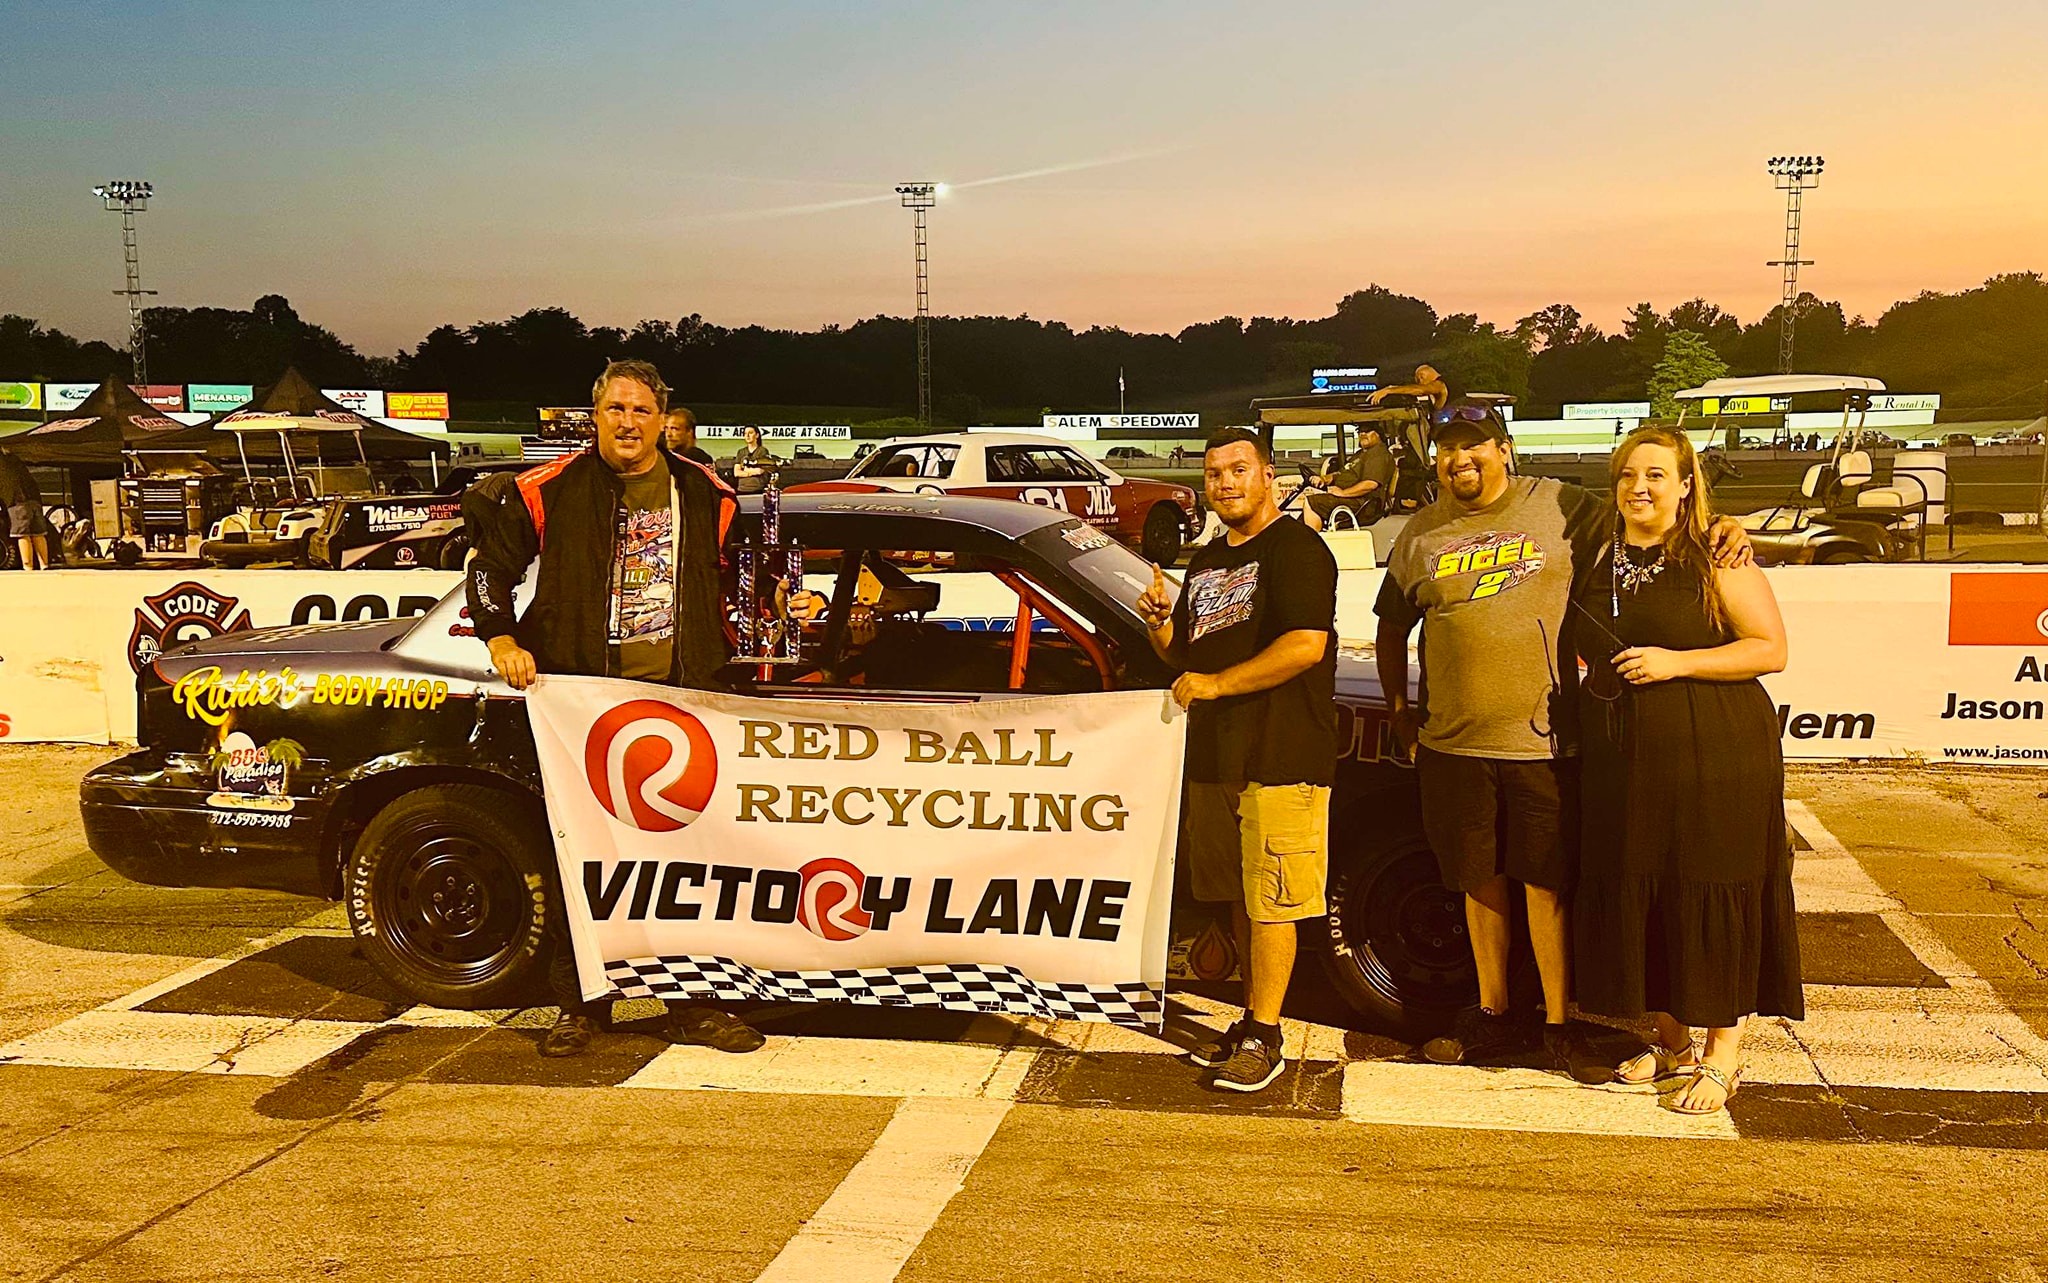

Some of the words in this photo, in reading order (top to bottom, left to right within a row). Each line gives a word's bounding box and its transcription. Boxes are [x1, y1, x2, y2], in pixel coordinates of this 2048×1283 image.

[193, 393, 248, 403] MENARDS
[1884, 396, 1918, 409] Rental
[771, 427, 796, 437] RACE
[801, 427, 812, 437] AT
[815, 427, 847, 437] SALEM
[1048, 416, 1102, 427] SALEM
[1110, 415, 1196, 427] SPEEDWAY
[1084, 485, 1117, 515] MR
[363, 506, 430, 524] Miles
[431, 511, 454, 519] FUEL
[1433, 540, 1544, 580] SIGEL
[164, 594, 219, 617] CODE
[172, 666, 302, 726] Richie's
[312, 674, 379, 707] BODY
[383, 678, 448, 710] SHOP
[1941, 693, 2044, 720] Jason
[738, 719, 878, 762] RED
[904, 728, 1073, 768] BALL
[229, 746, 270, 768] BBQ
[225, 763, 283, 780] Paradise
[736, 783, 1129, 833] RECYCLING
[583, 858, 912, 942] VICTORY
[925, 878, 1132, 942] LANE
